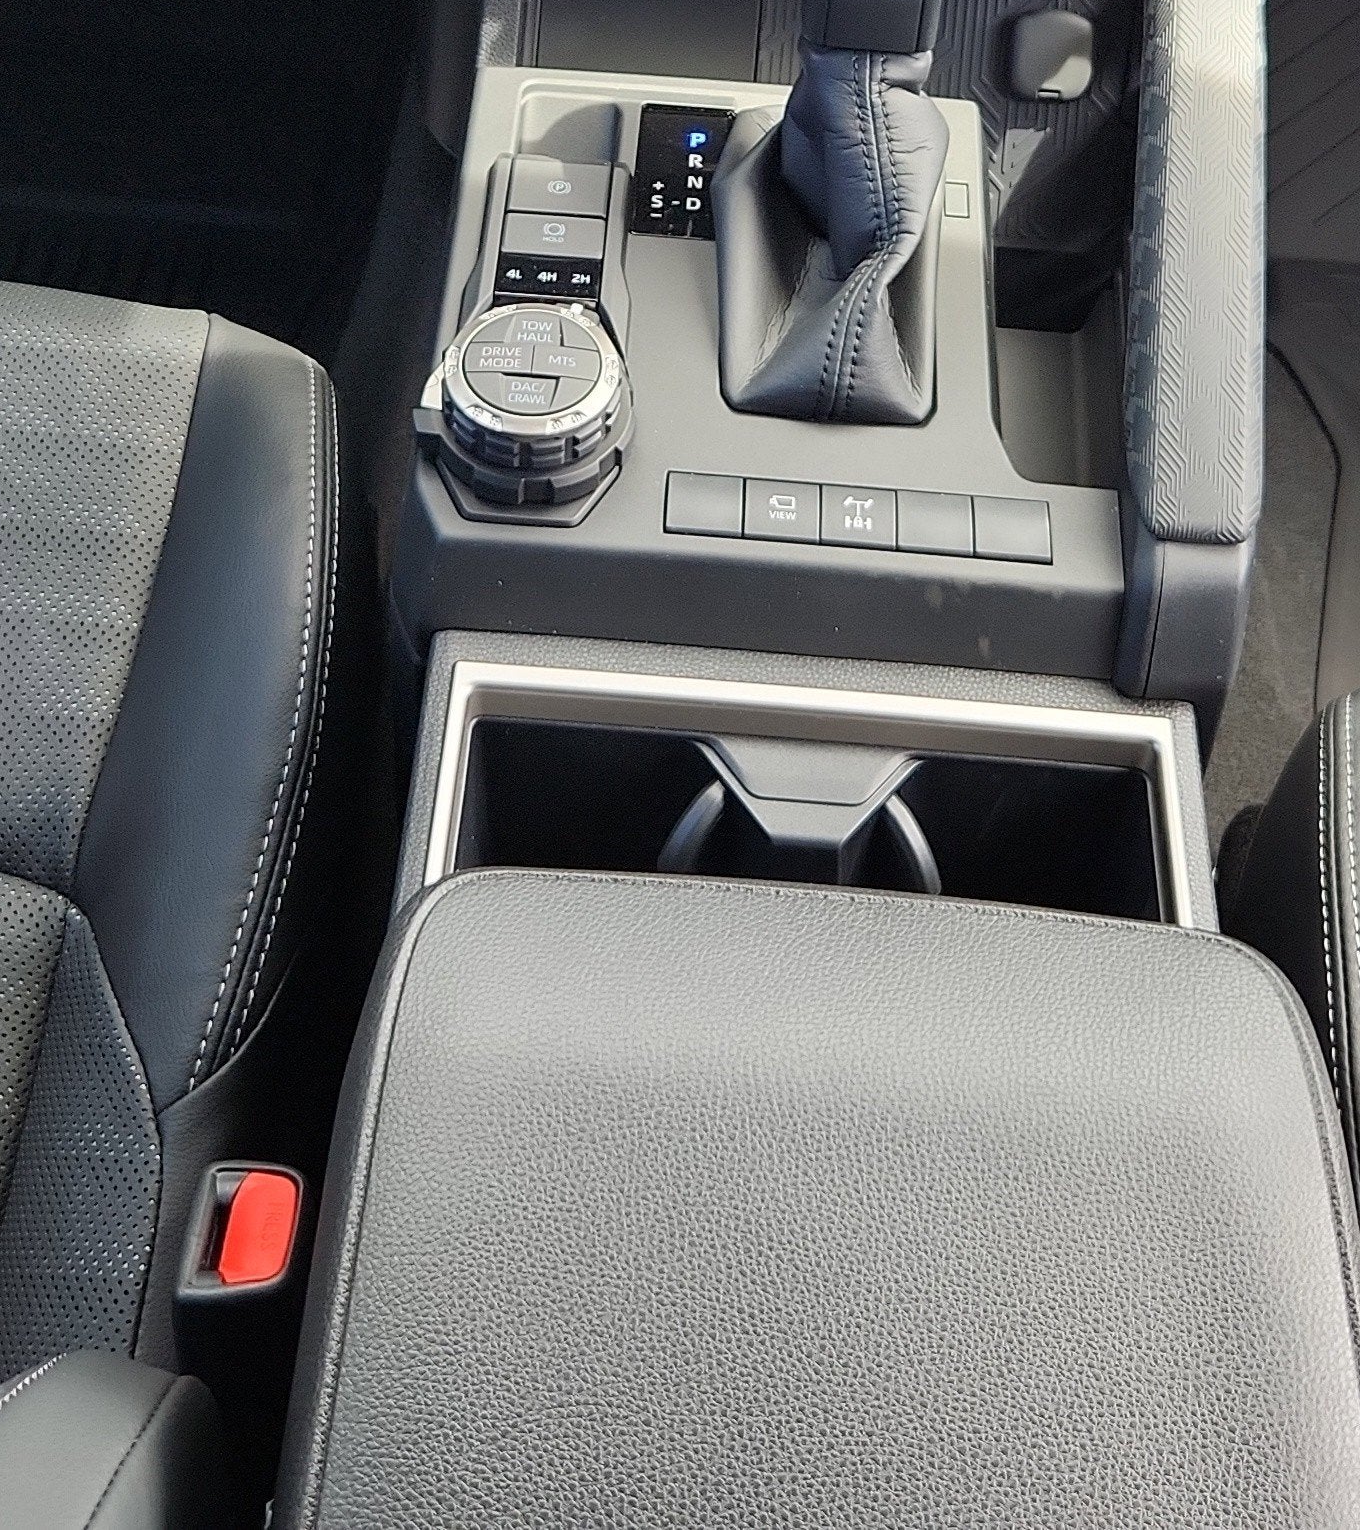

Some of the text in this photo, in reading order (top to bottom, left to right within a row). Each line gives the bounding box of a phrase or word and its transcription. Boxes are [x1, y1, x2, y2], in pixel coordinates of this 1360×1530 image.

[690, 132, 706, 148] P
[688, 154, 703, 169] R
[687, 176, 702, 189] N
[651, 195, 664, 208] S
[686, 197, 701, 211] D
[542, 235, 564, 243] HOLD
[506, 268, 590, 284] 4L 4H 2H
[521, 320, 553, 330] TOW
[517, 333, 554, 343] HAUL
[482, 346, 522, 356] DRIVE
[480, 357, 522, 368] MODE
[548, 355, 576, 367] MTS
[511, 381, 545, 391] DAC/
[508, 393, 547, 404] CRAWL
[768, 509, 797, 521] VIEW
